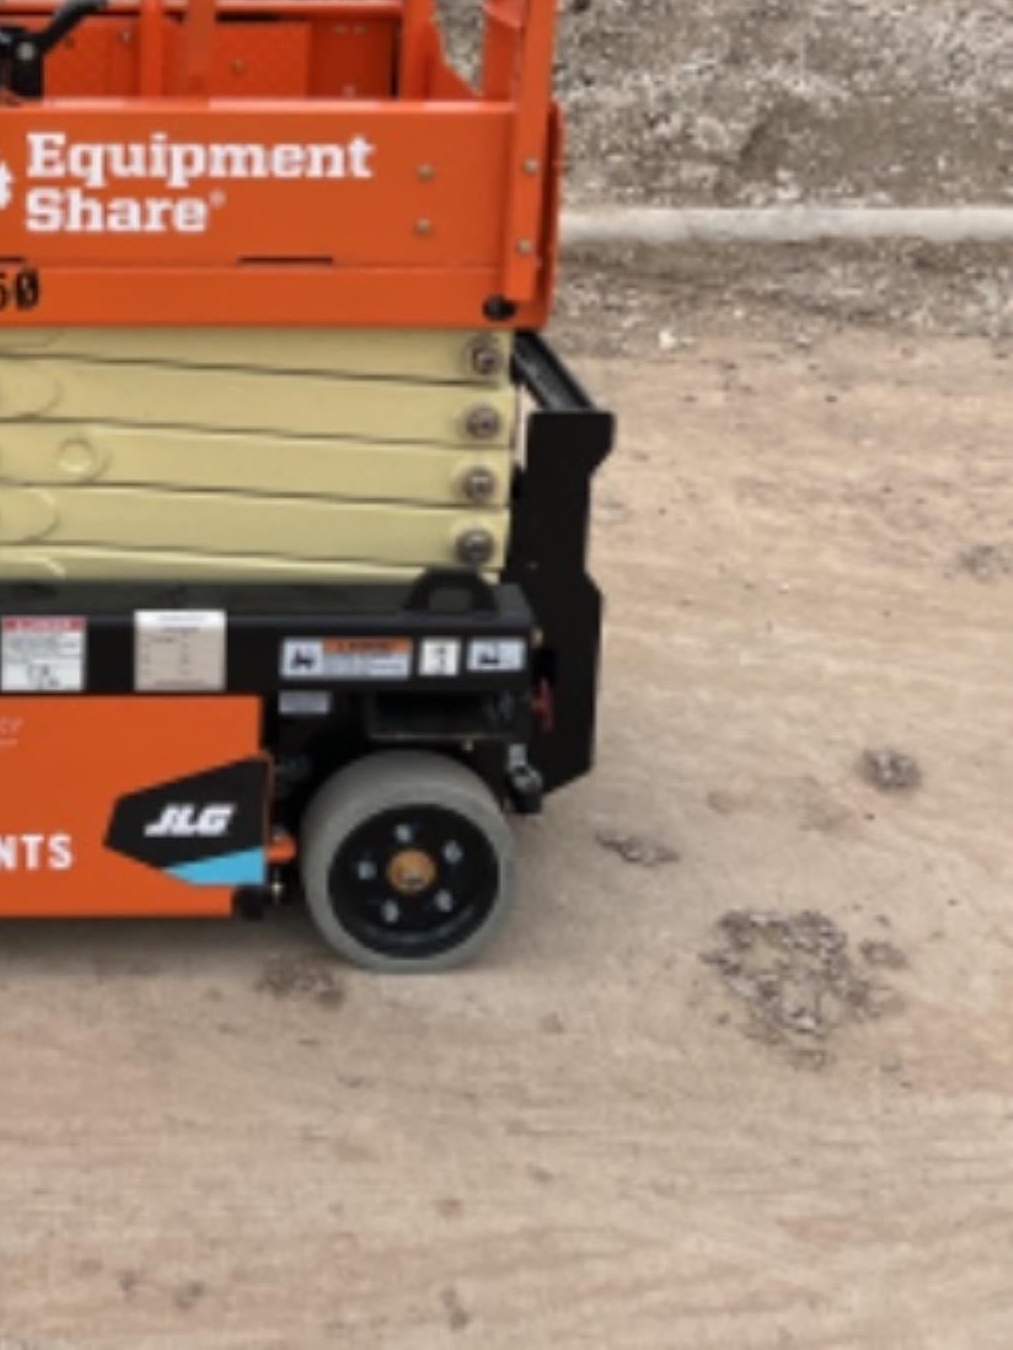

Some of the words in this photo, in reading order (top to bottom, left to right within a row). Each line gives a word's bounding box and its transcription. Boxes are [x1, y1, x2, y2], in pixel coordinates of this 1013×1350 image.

[26, 132, 374, 188] Equipment
[25, 187, 208, 233] Share
[143, 803, 236, 838] JLG
